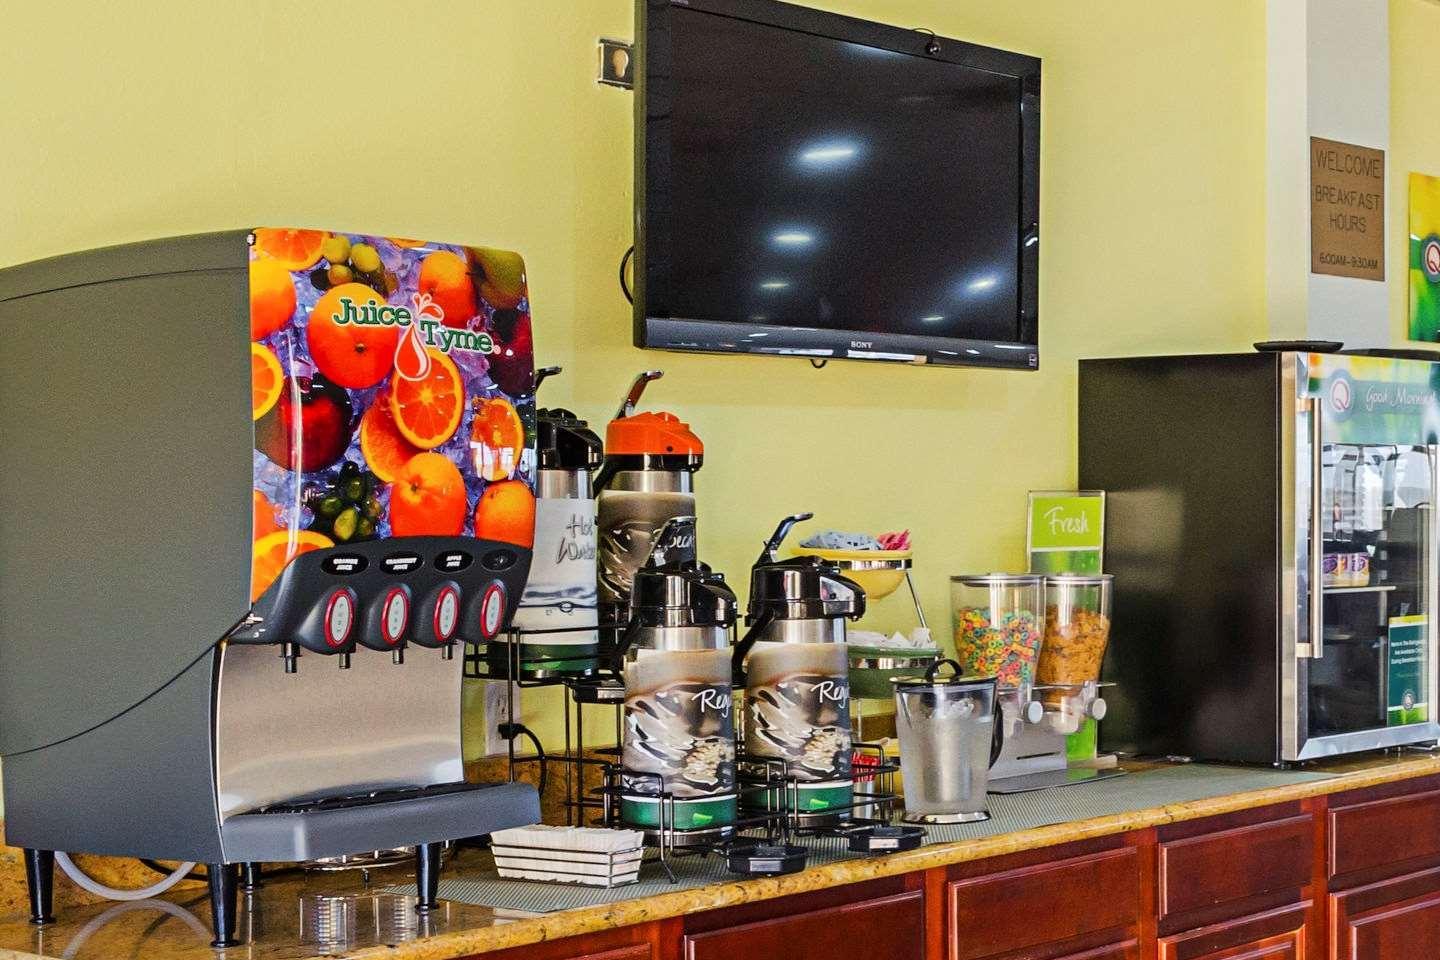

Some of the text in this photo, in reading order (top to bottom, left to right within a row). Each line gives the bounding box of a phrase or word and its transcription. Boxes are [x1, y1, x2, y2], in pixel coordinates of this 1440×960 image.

[1316, 151, 1380, 179] WELCOME
[1315, 185, 1380, 211] BREAKFAST
[1329, 214, 1367, 233] HOURS
[333, 299, 412, 326] Juice
[420, 320, 492, 352] Tyme
[850, 341, 873, 349] SONY
[1043, 506, 1088, 535] Fresh
